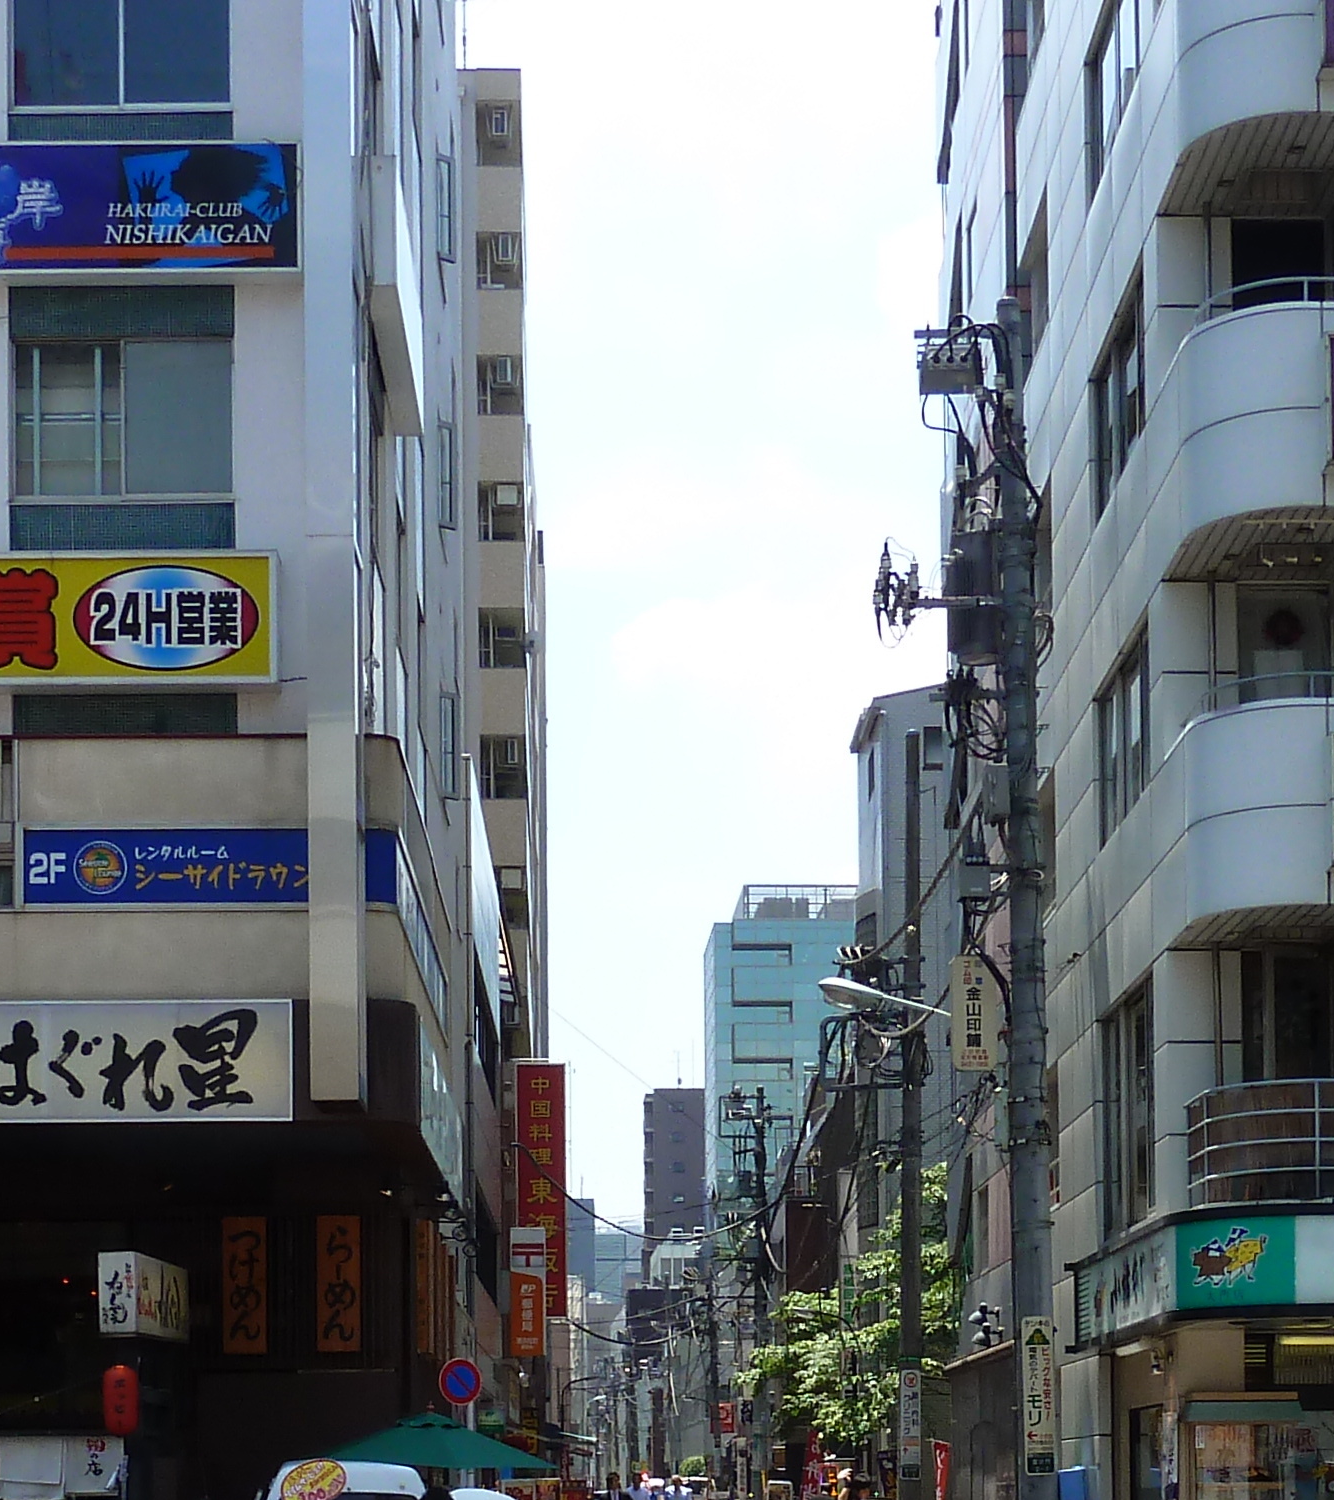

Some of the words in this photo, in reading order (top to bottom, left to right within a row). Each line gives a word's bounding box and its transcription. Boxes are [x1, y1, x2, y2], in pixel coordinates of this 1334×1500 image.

[107, 202, 244, 219] HAKURAI-CLUB
[104, 222, 273, 247] NISHIKAIGAN
[87, 586, 244, 649] 24H営業
[28, 852, 66, 885] 2F
[134, 845, 230, 860] レンタルルーム
[528, 1076, 553, 1167] 中国料理
[227, 1229, 263, 1342] つけめん
[322, 1224, 358, 1342] らーめん
[1027, 1394, 1043, 1426] モリ
